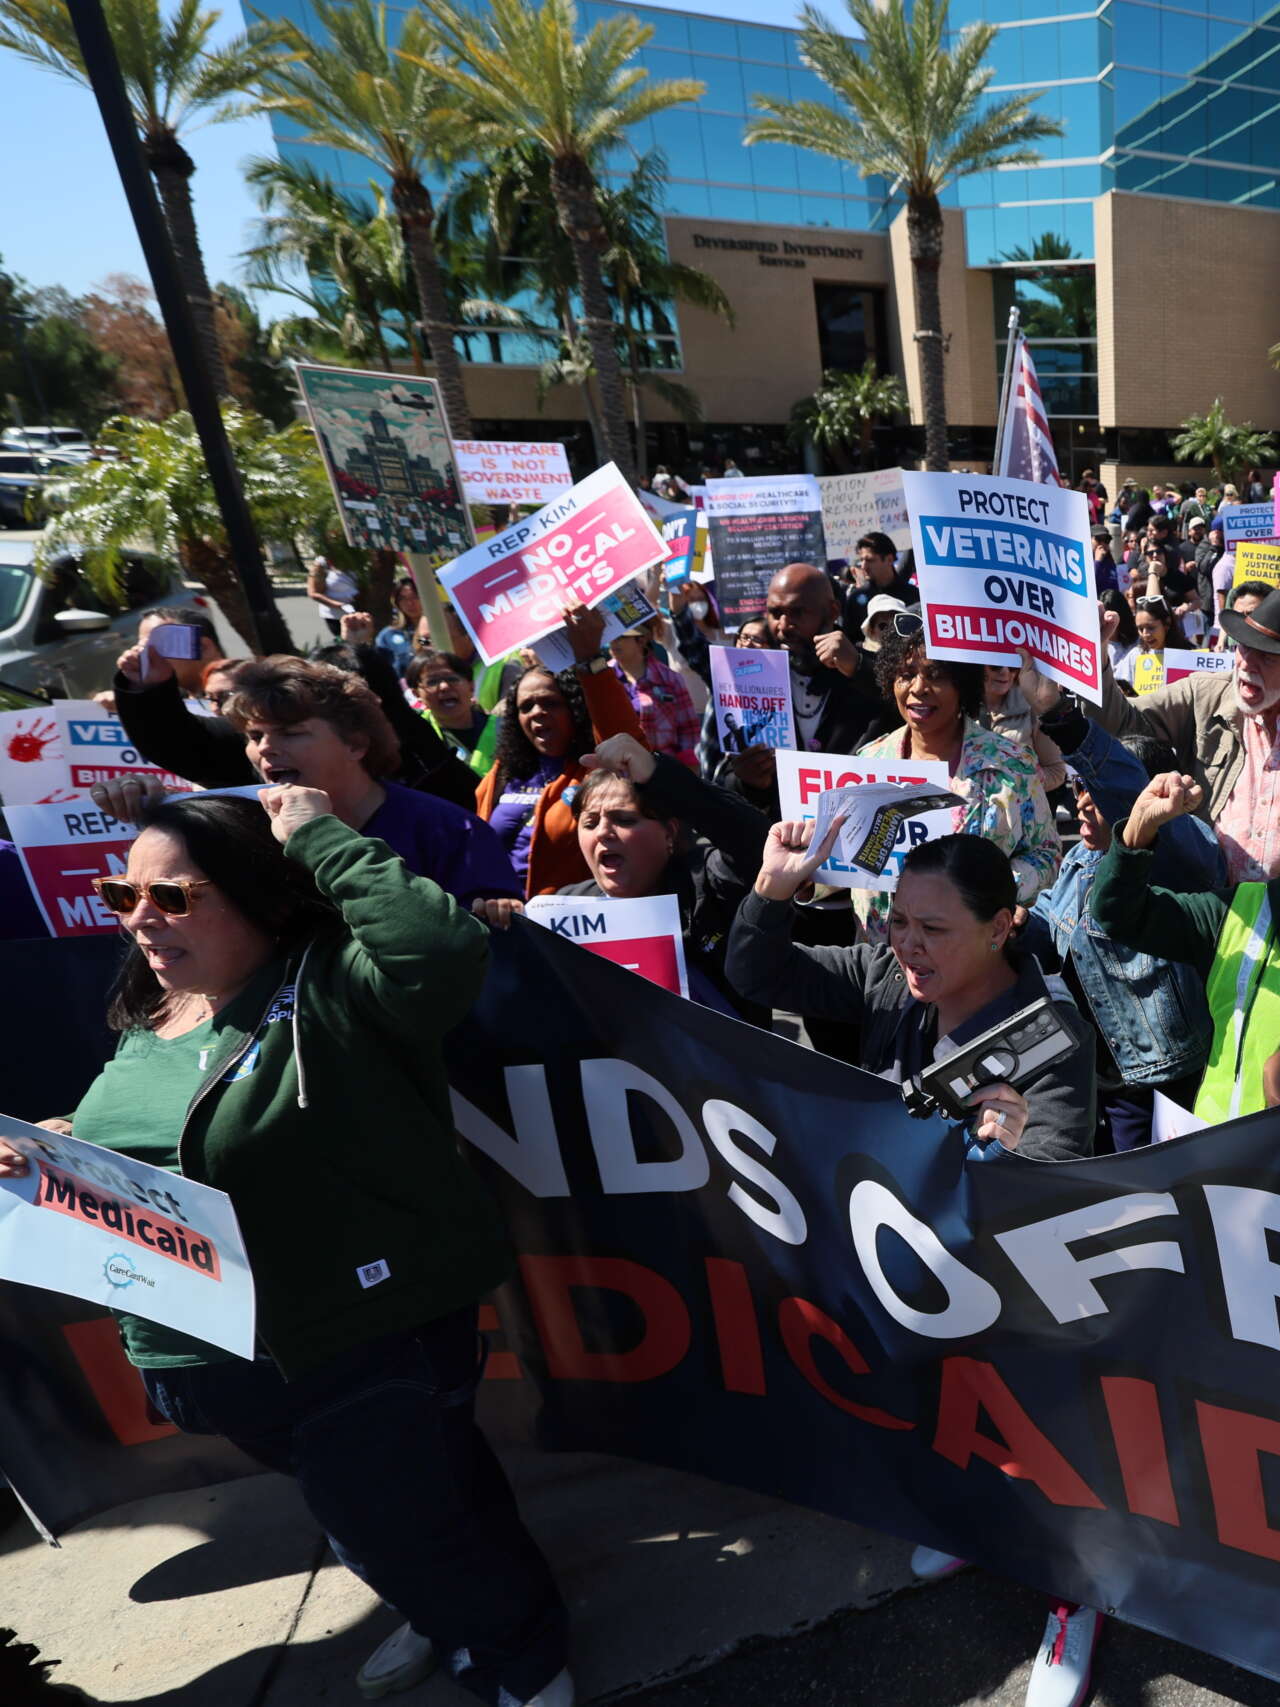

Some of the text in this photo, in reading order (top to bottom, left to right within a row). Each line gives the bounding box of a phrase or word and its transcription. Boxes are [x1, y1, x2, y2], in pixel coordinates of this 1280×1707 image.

[453, 443, 560, 457] HEALTHCARE
[461, 471, 571, 483] GOVERNMENT
[481, 459, 546, 470] IS NOT
[485, 488, 542, 500] WASTE
[957, 489, 1050, 525] PROTECT
[488, 498, 577, 558] REP. KIM
[1228, 516, 1273, 528] VETERA
[1245, 529, 1273, 537] OVER
[521, 533, 573, 573] NO
[925, 525, 1083, 585] VETERANS
[1242, 551, 1255, 560] WE
[478, 522, 636, 623] MEDI-CAL
[1246, 561, 1280, 571] JUSTICE
[984, 575, 1057, 619] OVER
[935, 613, 1094, 677] BILLIONAIRES
[1196, 656, 1226, 670] REP.
[719, 693, 786, 712] HANDS OFF
[64, 811, 127, 837] REP.
[550, 913, 607, 938] KIM
[450, 1056, 809, 1246] NDS
[43, 1167, 215, 1274] Medicaid
